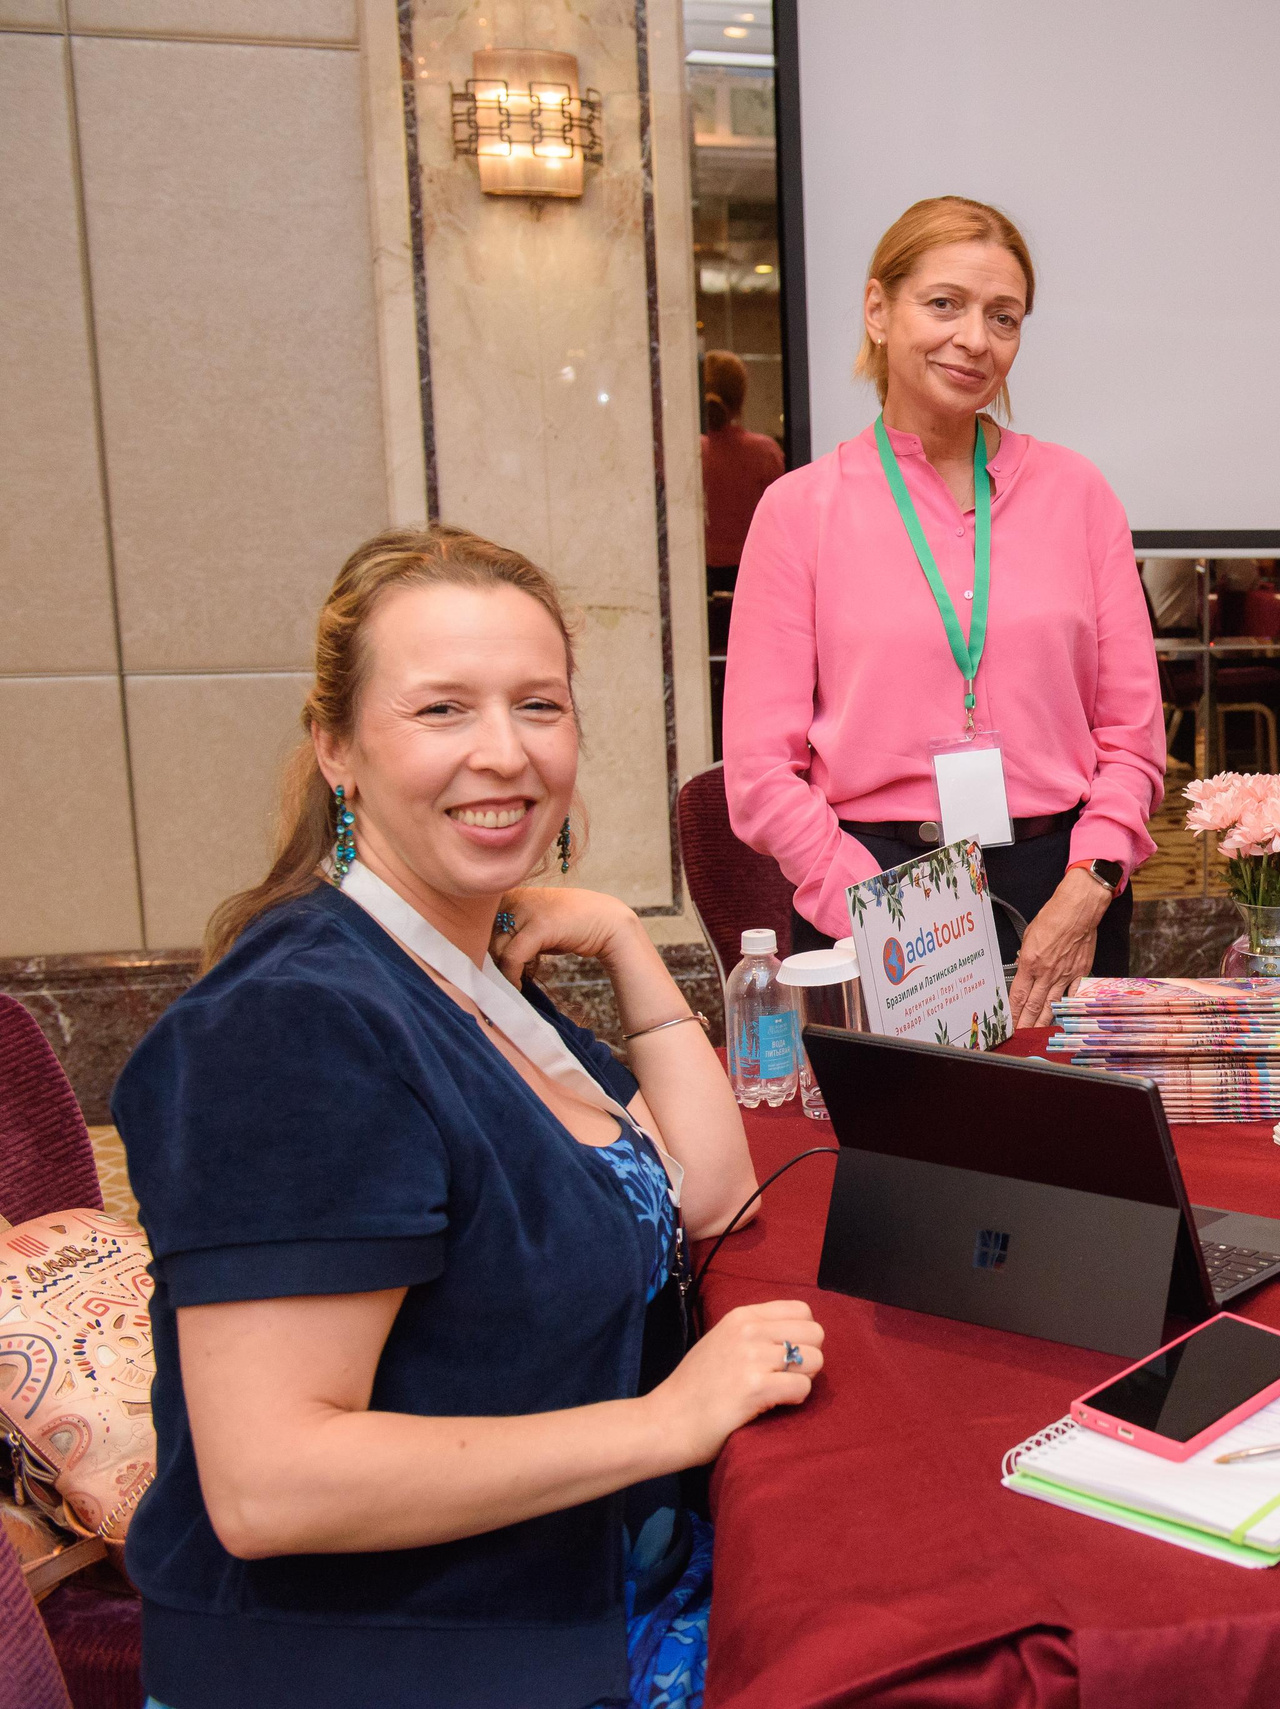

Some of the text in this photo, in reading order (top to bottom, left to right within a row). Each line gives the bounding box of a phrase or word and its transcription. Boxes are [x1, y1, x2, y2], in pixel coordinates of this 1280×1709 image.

[905, 911, 975, 964] adatours
[885, 948, 985, 1011] Бразилия и Латинская Америка
[904, 972, 974, 1018] Аргентина Перу Чили
[894, 978, 986, 1037] Эквадор Коста Рика Панама
[771, 1039, 786, 1049] ВОДА
